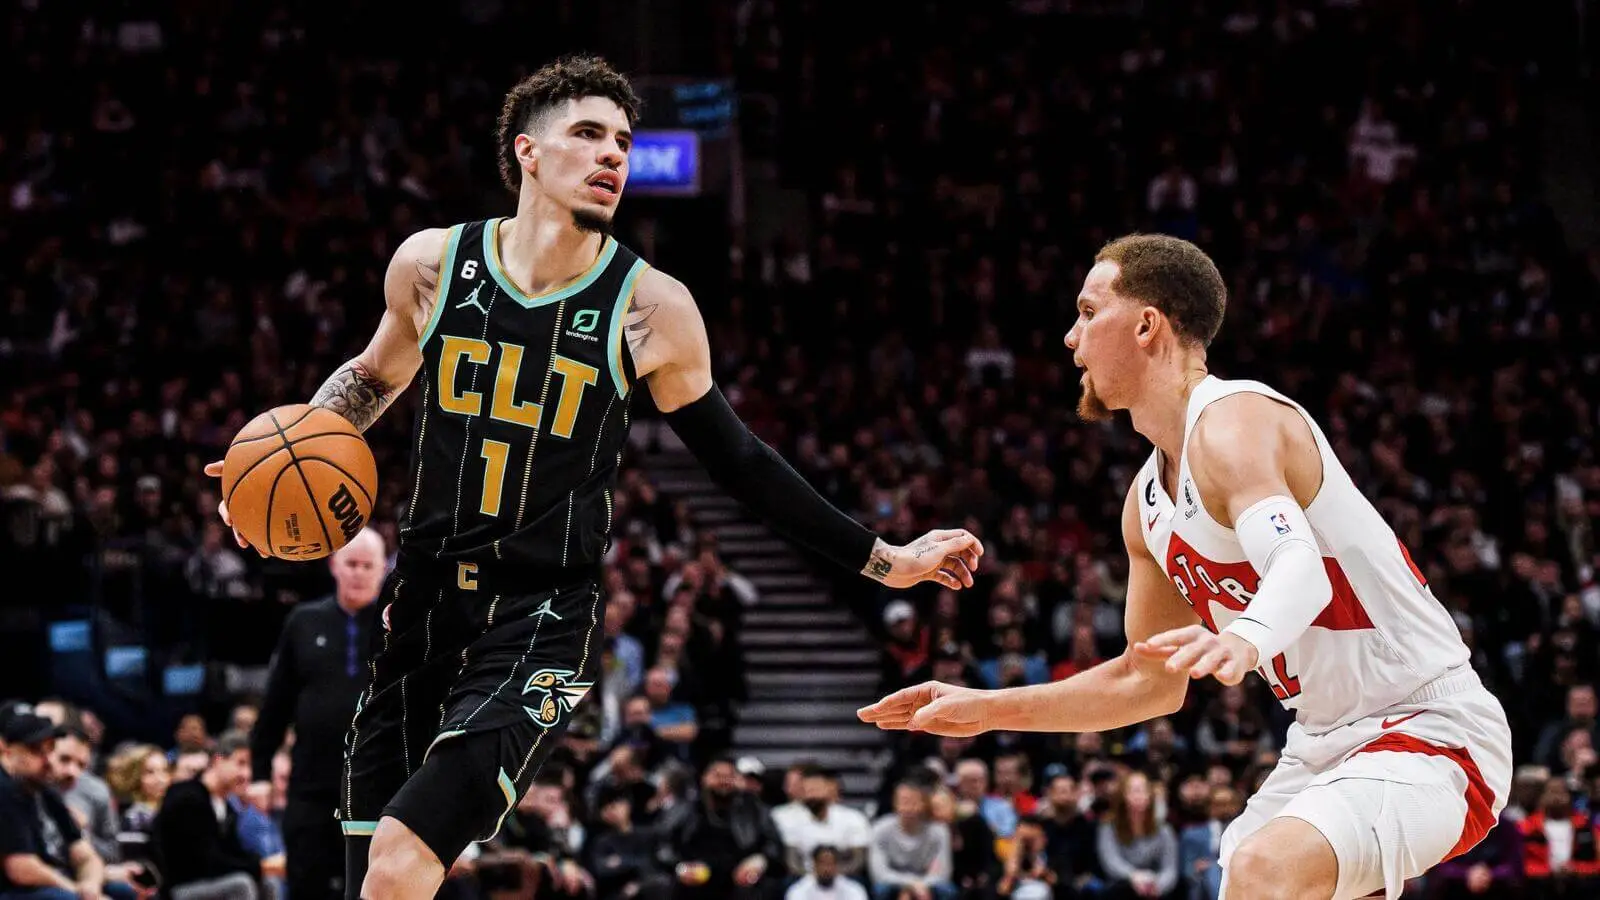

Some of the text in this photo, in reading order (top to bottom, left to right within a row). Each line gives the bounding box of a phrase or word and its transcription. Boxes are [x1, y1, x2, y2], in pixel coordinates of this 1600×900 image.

[460, 260, 479, 280] 6
[566, 329, 599, 342] lendingtree
[438, 335, 600, 440] CLT
[480, 438, 510, 517] 1
[457, 561, 479, 590] C
[1174, 553, 1261, 606] PTOR
